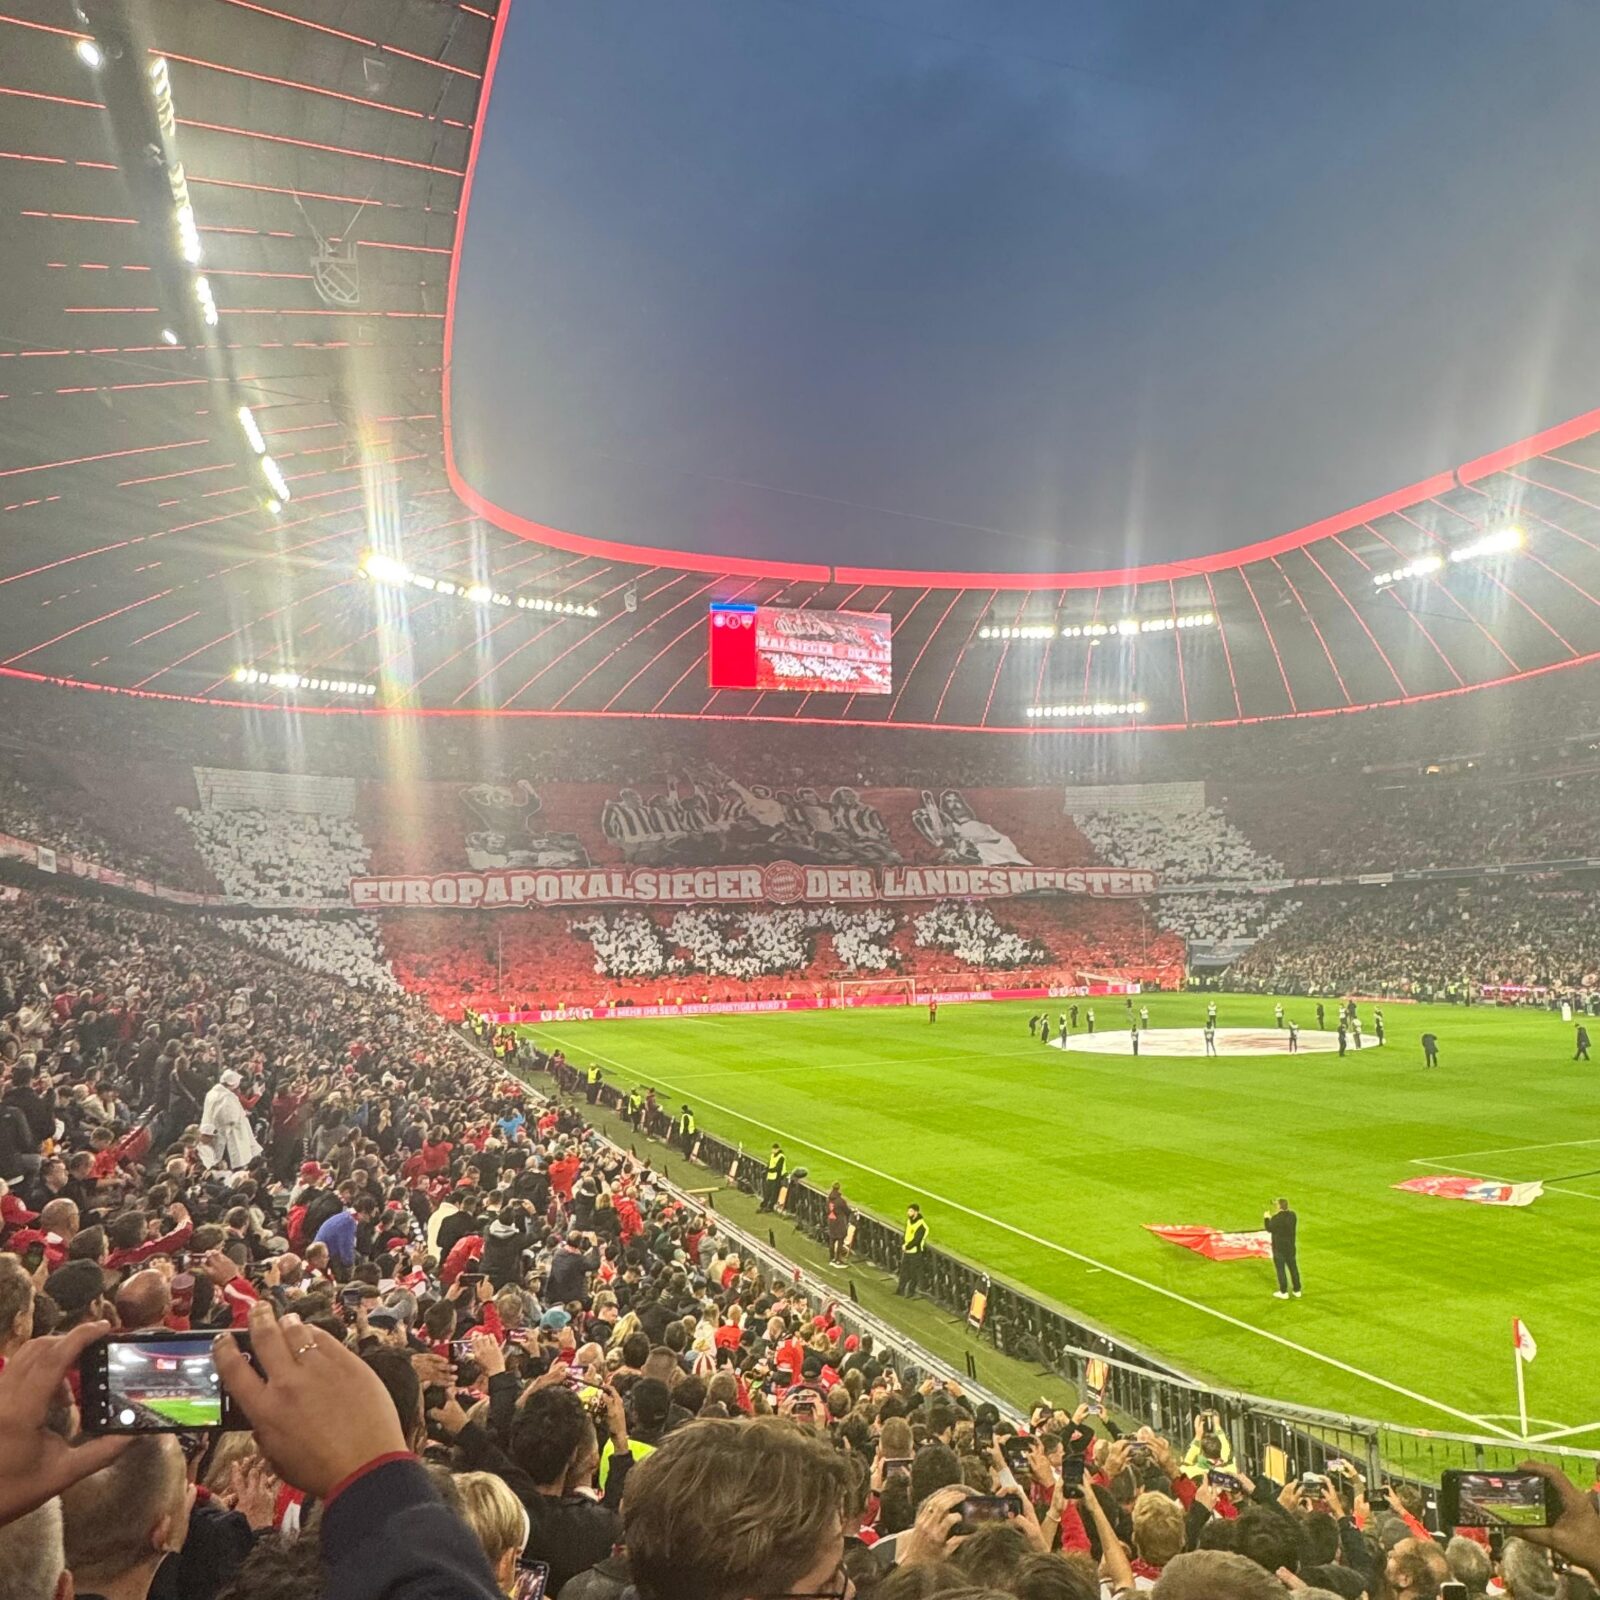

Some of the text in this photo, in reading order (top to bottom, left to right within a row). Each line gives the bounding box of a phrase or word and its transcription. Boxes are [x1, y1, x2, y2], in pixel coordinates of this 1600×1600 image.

[353, 870, 763, 903] EUROPAPOKALSIEGER
[806, 869, 874, 898] DER
[884, 870, 1156, 897] LANDESMEISTER
